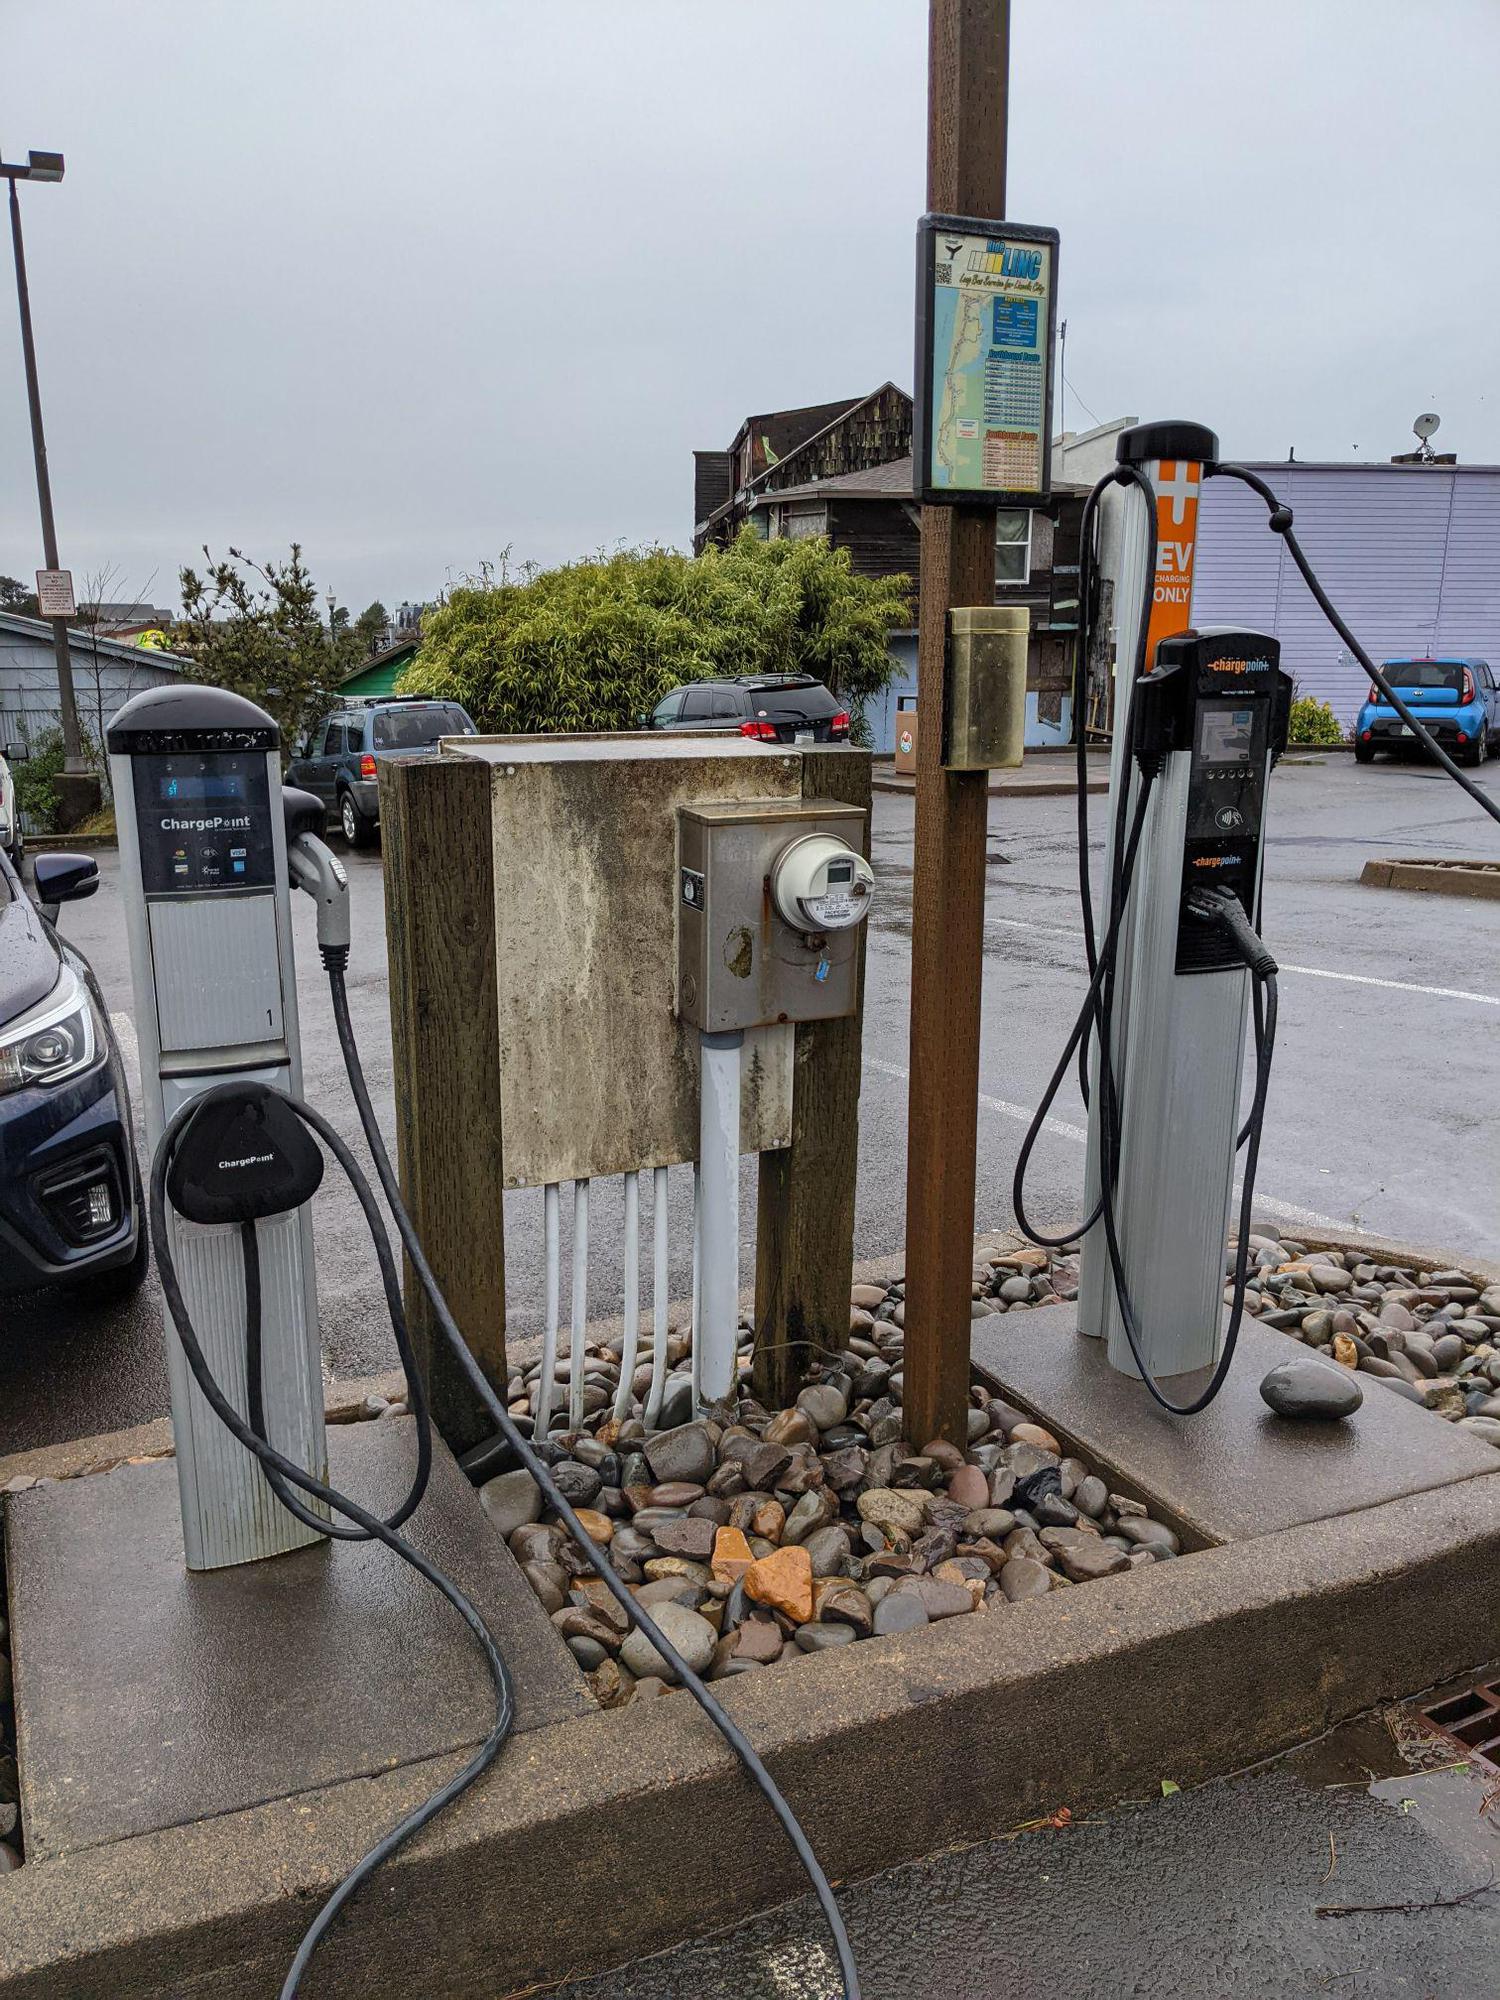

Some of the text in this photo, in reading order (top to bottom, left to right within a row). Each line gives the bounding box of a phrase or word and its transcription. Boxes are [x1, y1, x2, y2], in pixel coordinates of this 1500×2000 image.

[1001, 247, 1042, 280] LINC
[1156, 541, 1193, 572] EV
[1154, 573, 1190, 584] CHARGING
[1153, 586, 1190, 603] ONLY
[1208, 658, 1269, 674] chargepoint
[161, 815, 251, 831] ChargePoint
[1192, 855, 1241, 868] chargepoint
[219, 1153, 274, 1168] ChargePoint
